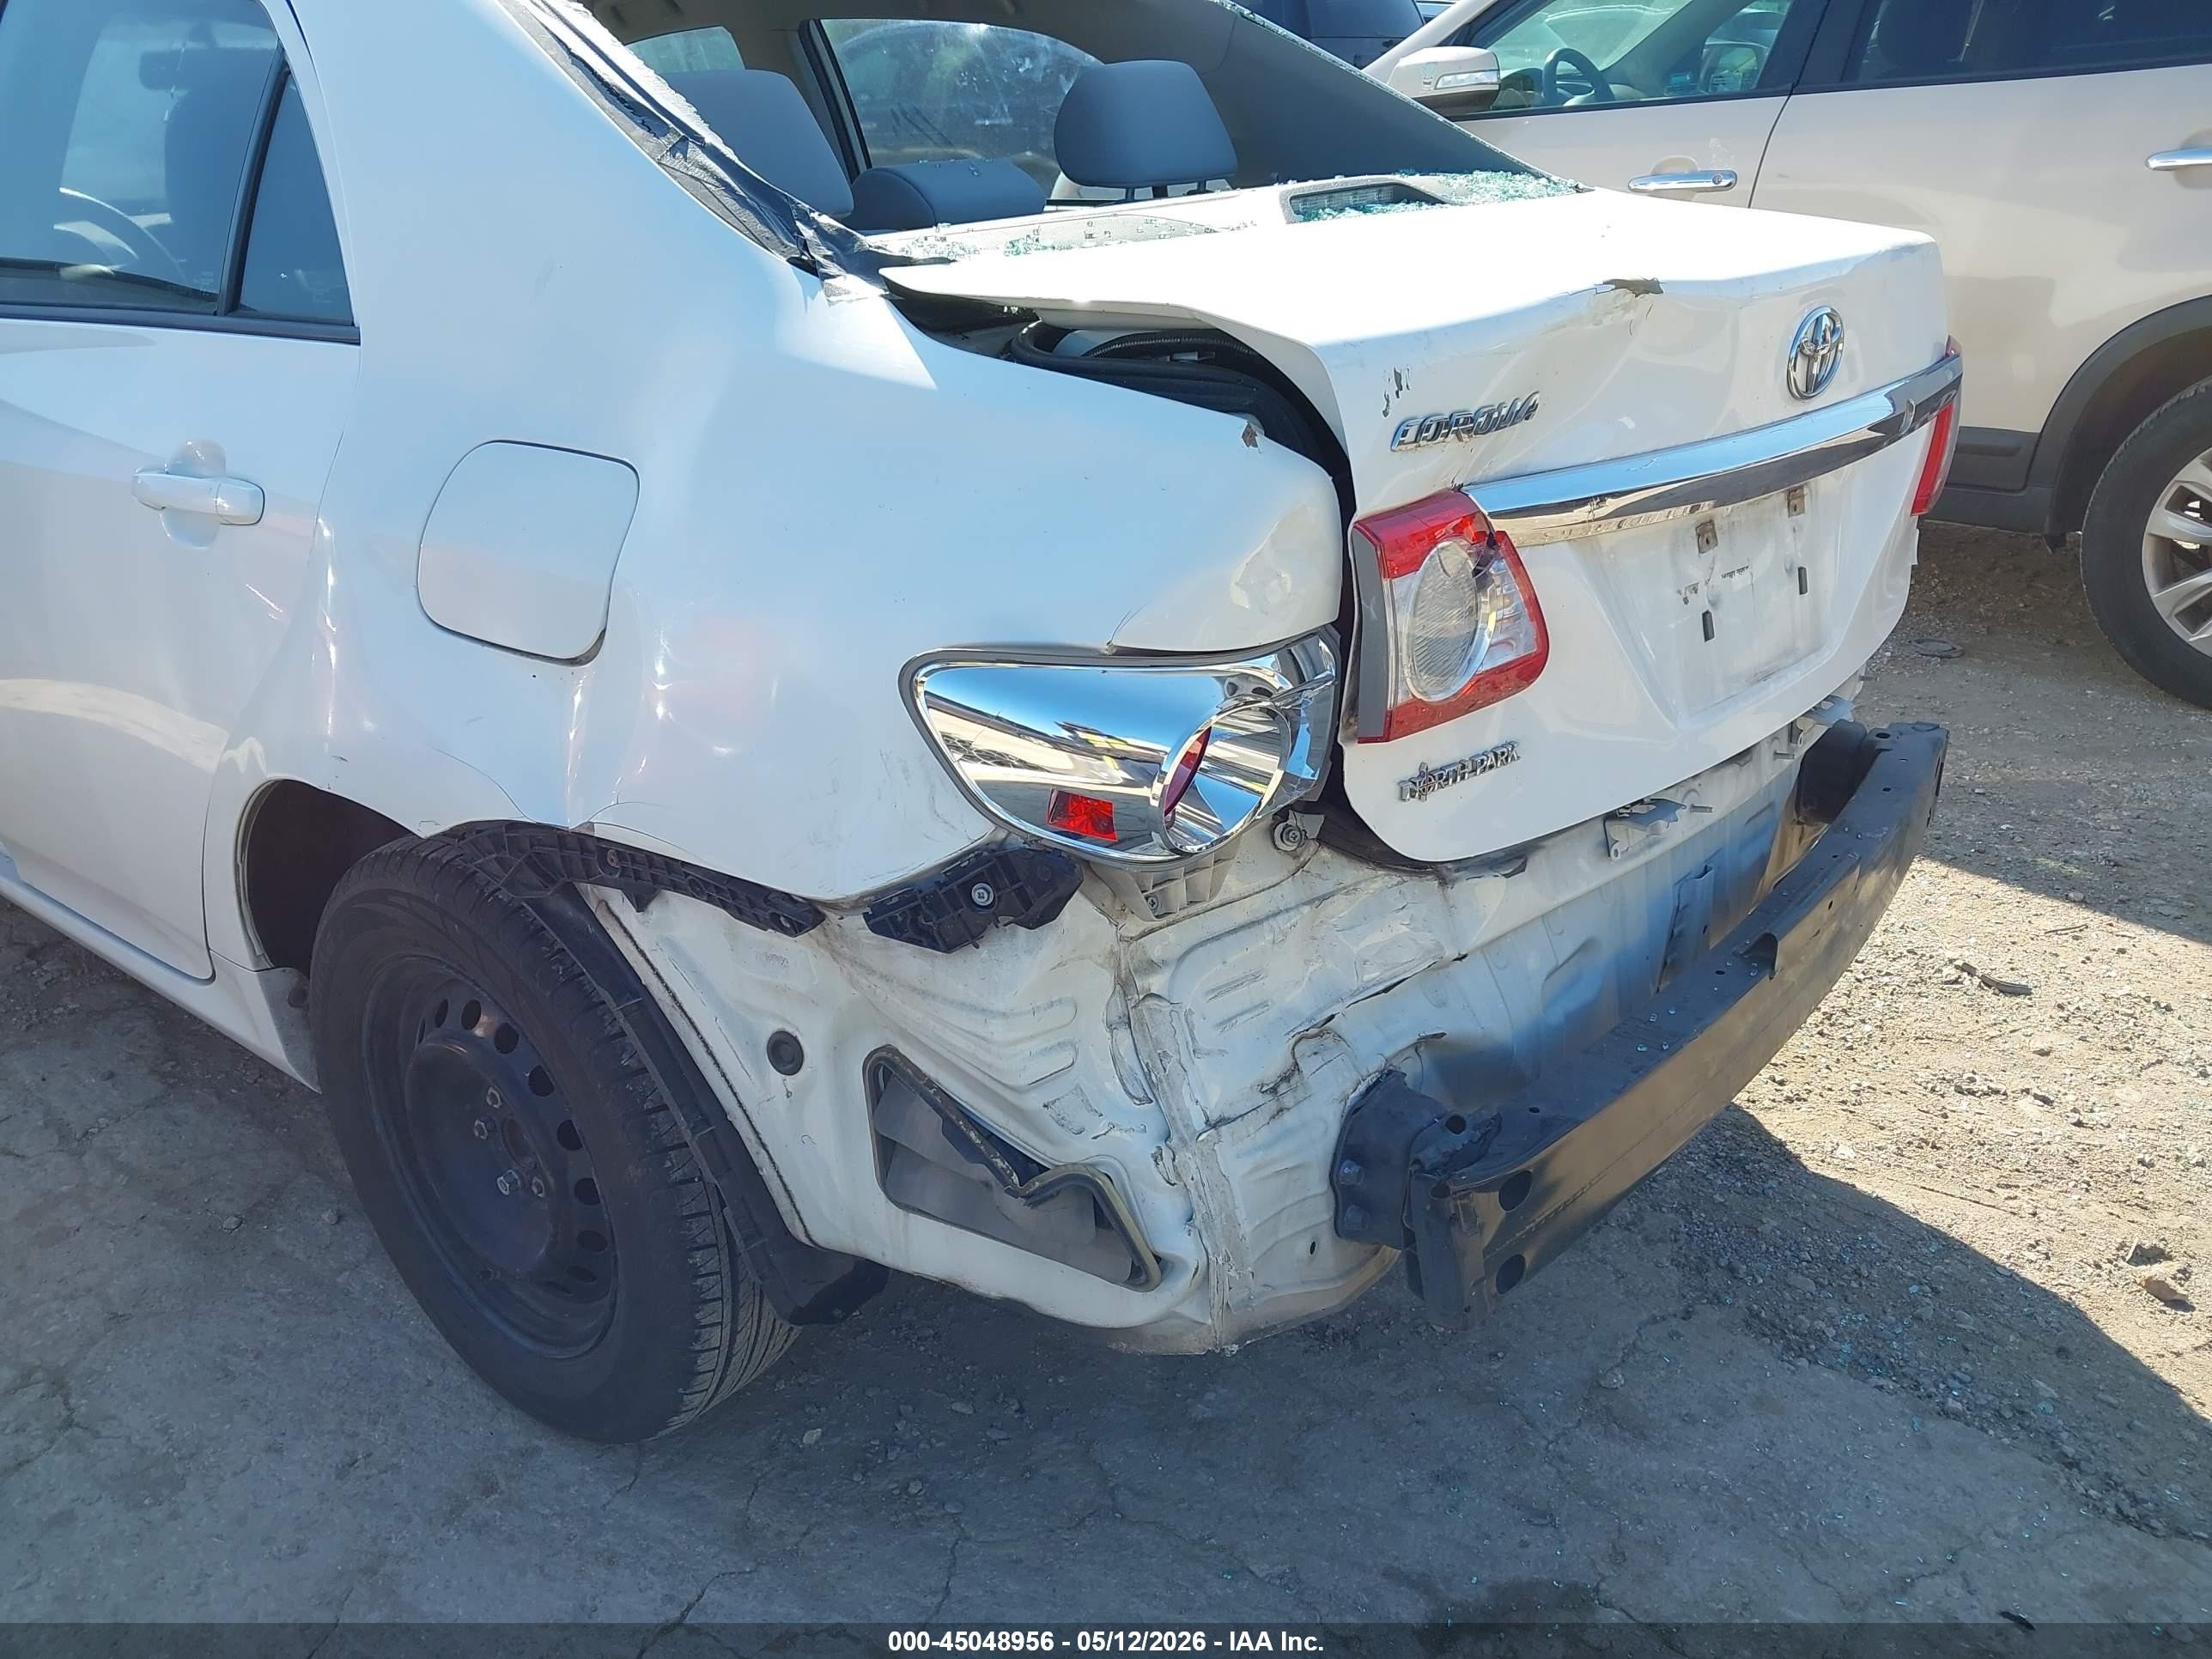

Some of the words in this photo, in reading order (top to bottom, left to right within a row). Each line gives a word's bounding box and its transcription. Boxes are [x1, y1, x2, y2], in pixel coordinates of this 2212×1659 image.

[1390, 391, 1540, 452] COROLLA
[1399, 760, 1472, 802] NORTH
[1472, 740, 1521, 775] PARK
